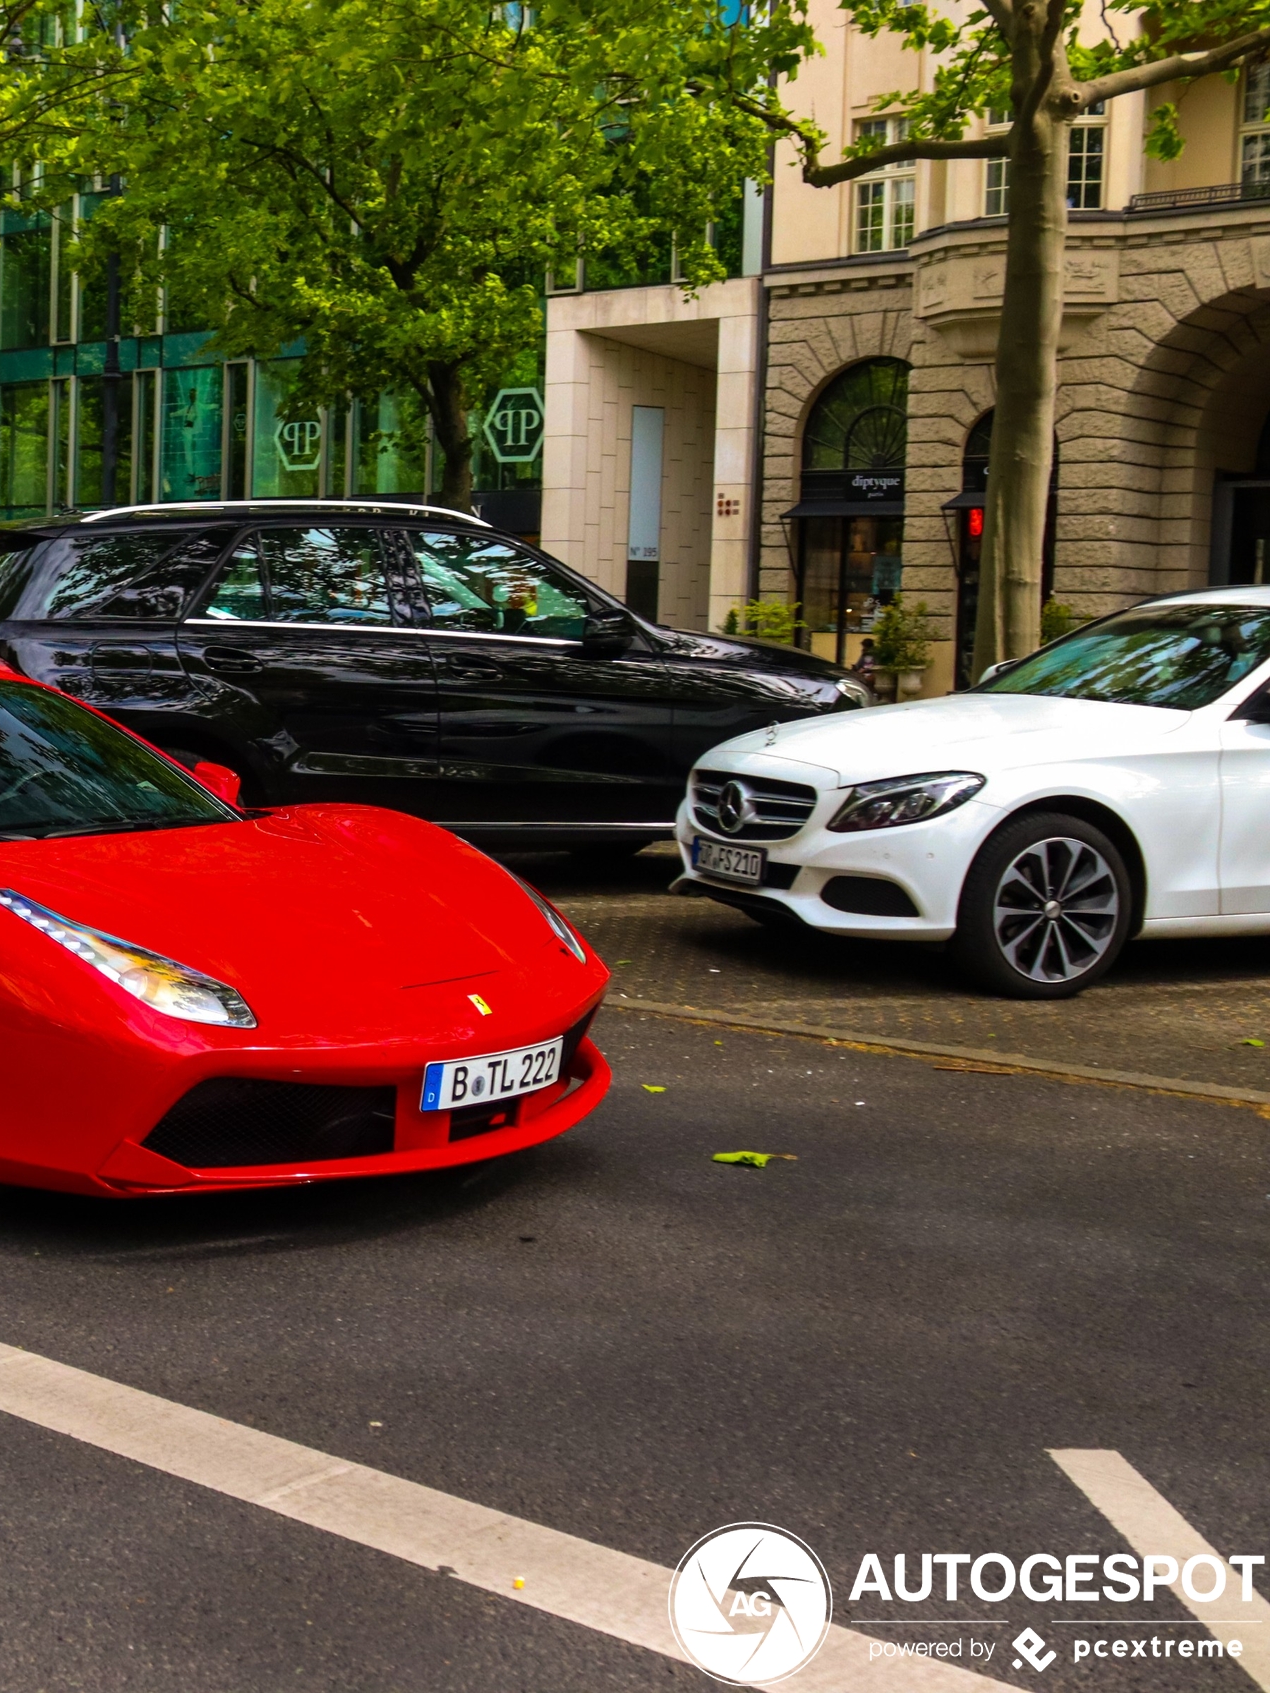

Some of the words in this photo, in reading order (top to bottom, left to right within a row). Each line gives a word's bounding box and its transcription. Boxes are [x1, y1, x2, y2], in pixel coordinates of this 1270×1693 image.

[851, 475, 901, 490] diptyque
[643, 547, 657, 557] 195
[734, 851, 759, 876] 210
[451, 1066, 469, 1102] B
[487, 1059, 514, 1095] TL
[519, 1047, 556, 1089] 222
[427, 1092, 435, 1103] D
